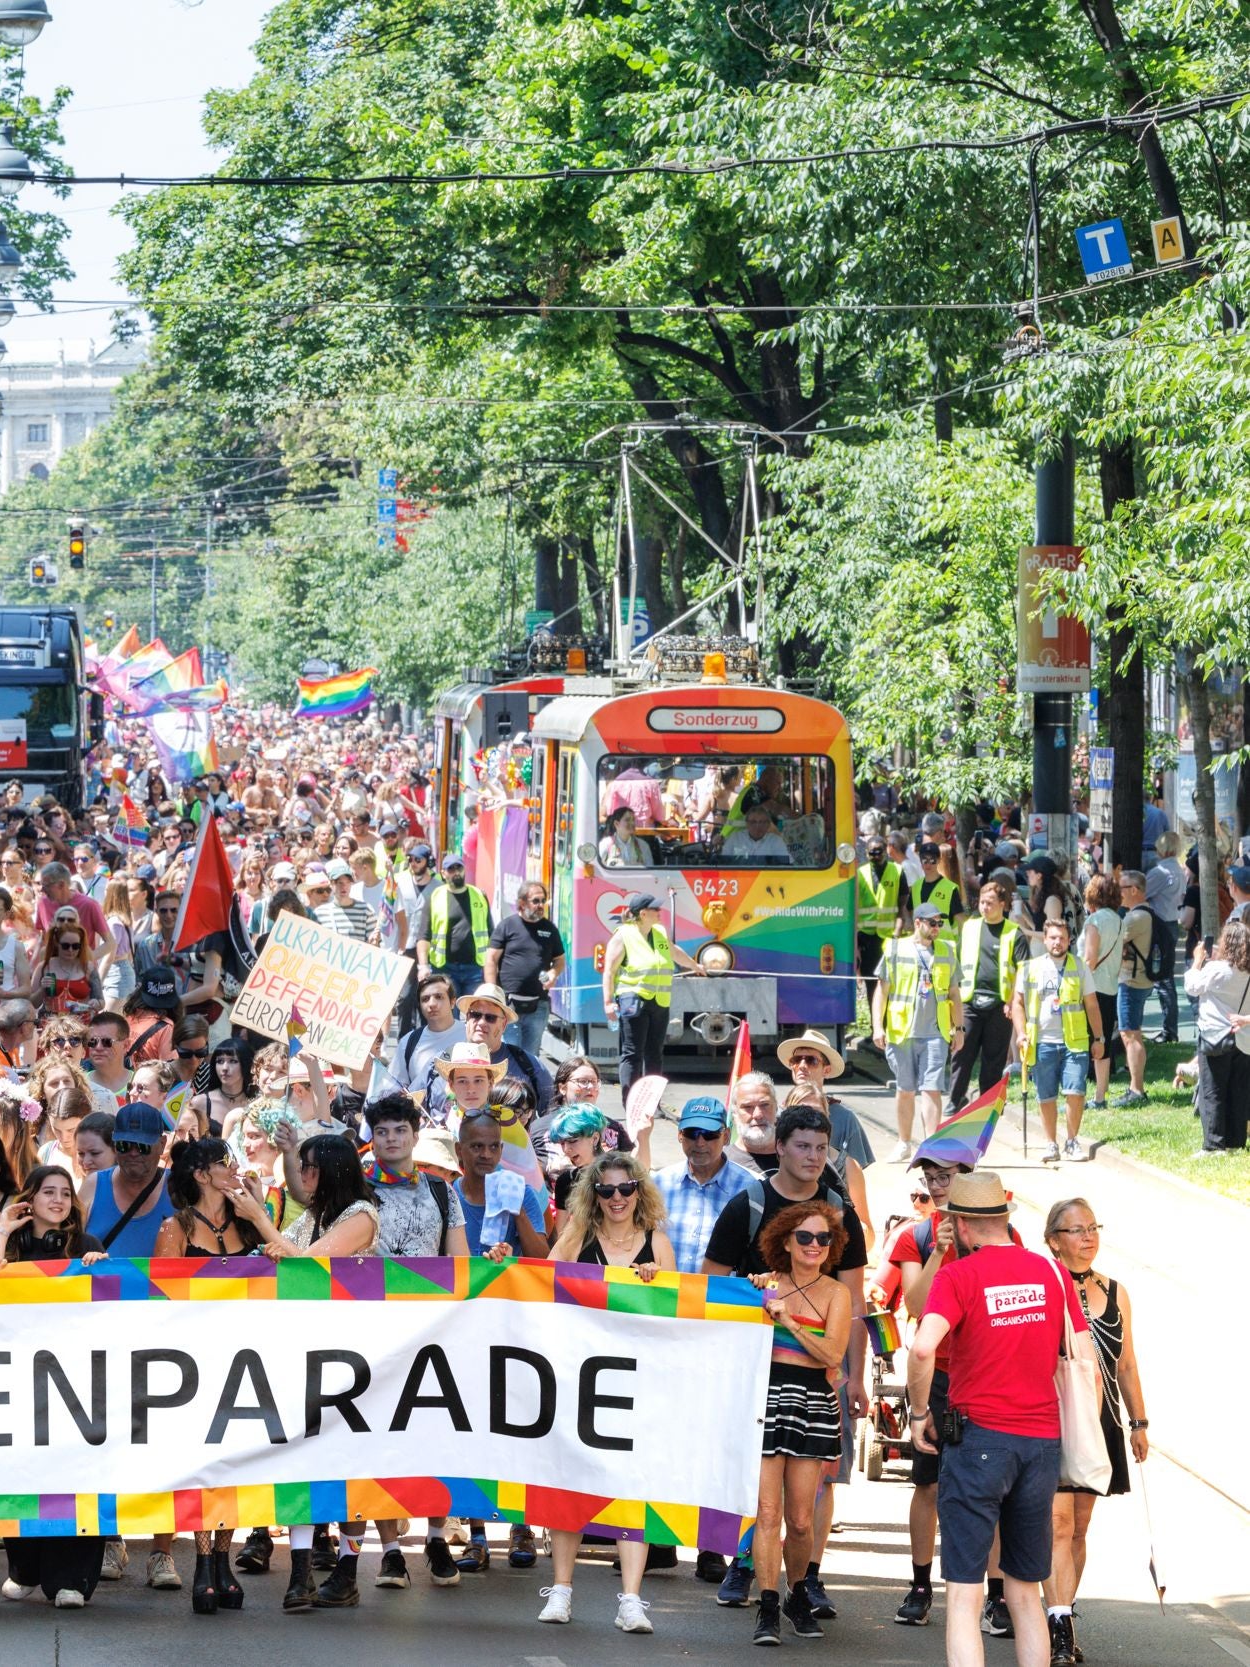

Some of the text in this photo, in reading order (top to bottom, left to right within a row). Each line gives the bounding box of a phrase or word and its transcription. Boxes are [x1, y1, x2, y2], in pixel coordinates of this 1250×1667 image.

[1084, 226, 1115, 265] T
[1161, 227, 1177, 249] A
[1094, 266, 1126, 281] T028/B
[1025, 554, 1077, 572] PRATER
[673, 712, 758, 729] Sonderzug
[693, 879, 739, 896] 6423
[753, 905, 844, 917] #WeRideWithPride
[274, 918, 398, 986] UKRANIAN
[264, 944, 382, 1010] QUEERS
[249, 967, 381, 1037] DEFENDING
[322, 1027, 368, 1060] PEACE
[985, 1289, 1030, 1300] regenbogen
[994, 1290, 1046, 1311] parade
[990, 1312, 1046, 1328] ORGANISATION
